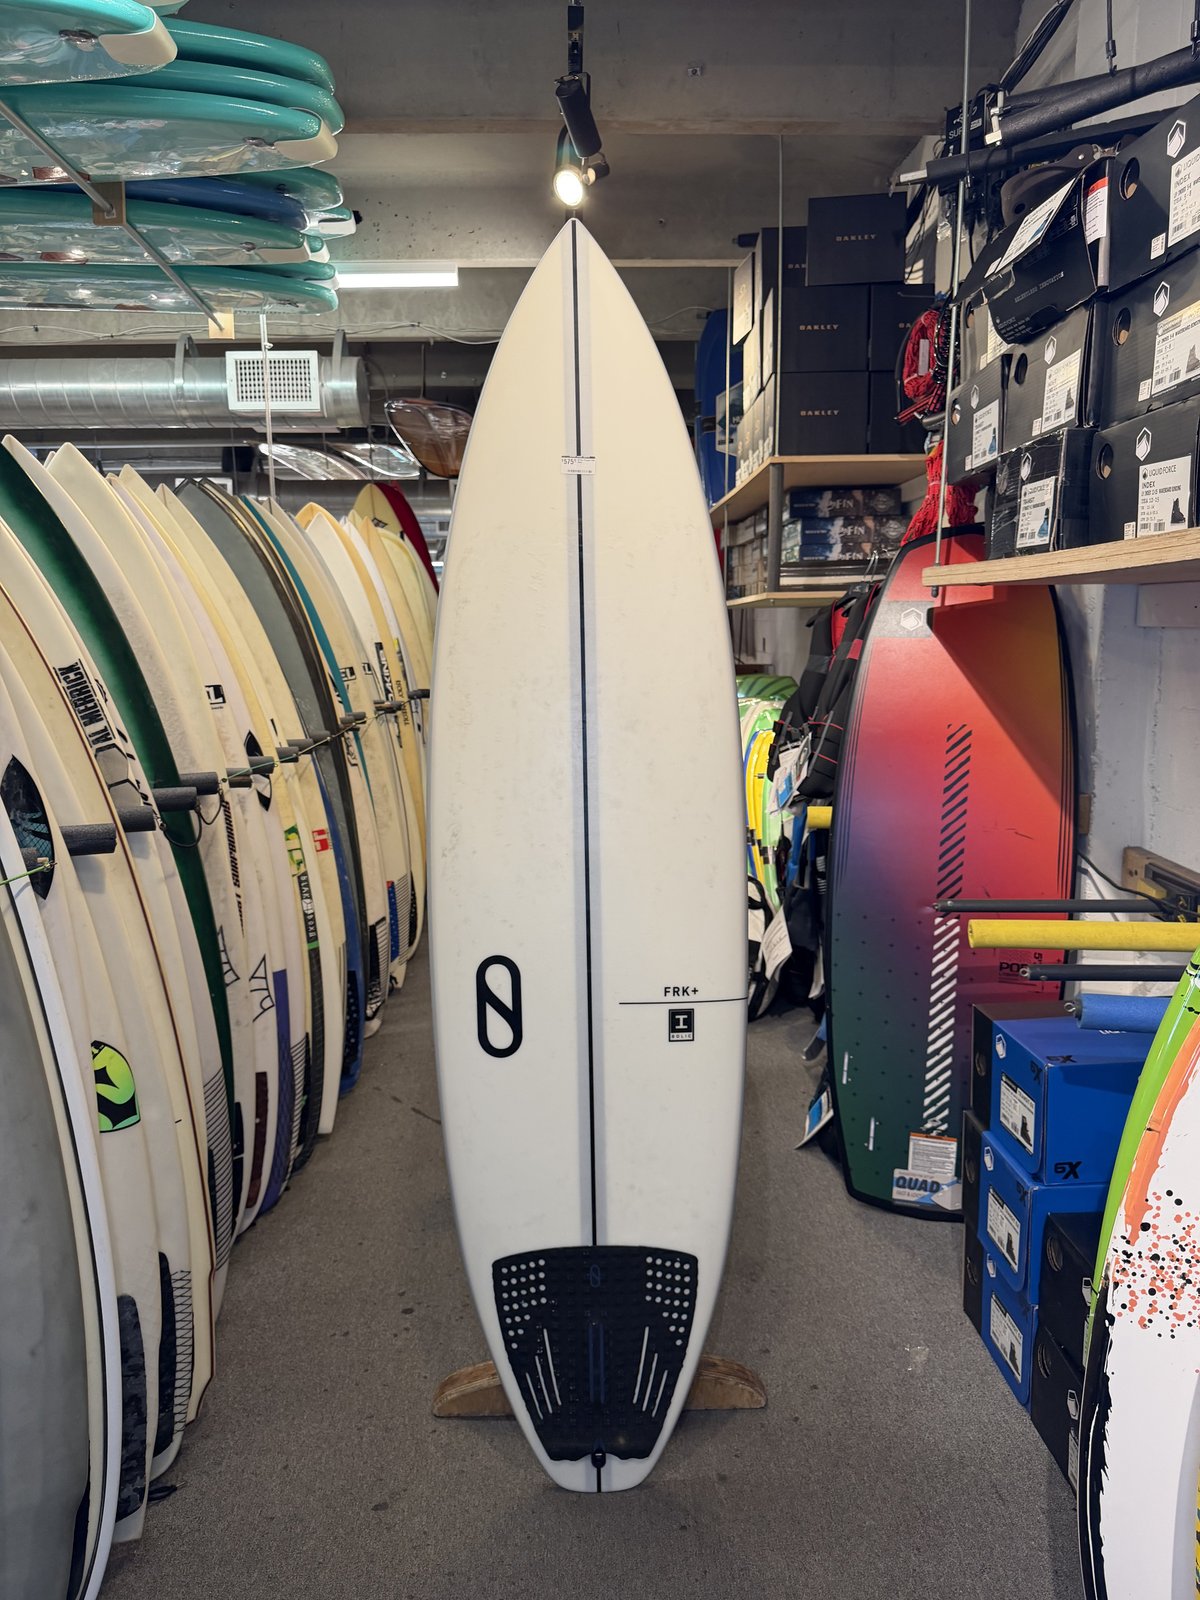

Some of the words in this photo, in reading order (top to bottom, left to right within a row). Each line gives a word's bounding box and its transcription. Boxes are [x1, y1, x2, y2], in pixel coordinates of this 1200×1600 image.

[836, 233, 876, 242] OAKLEY
[88, 725, 113, 746] AL
[663, 986, 699, 997] FRK+
[675, 1015, 688, 1029] I
[1054, 1161, 1082, 1180] 6X
[895, 1176, 941, 1193] QUAD
